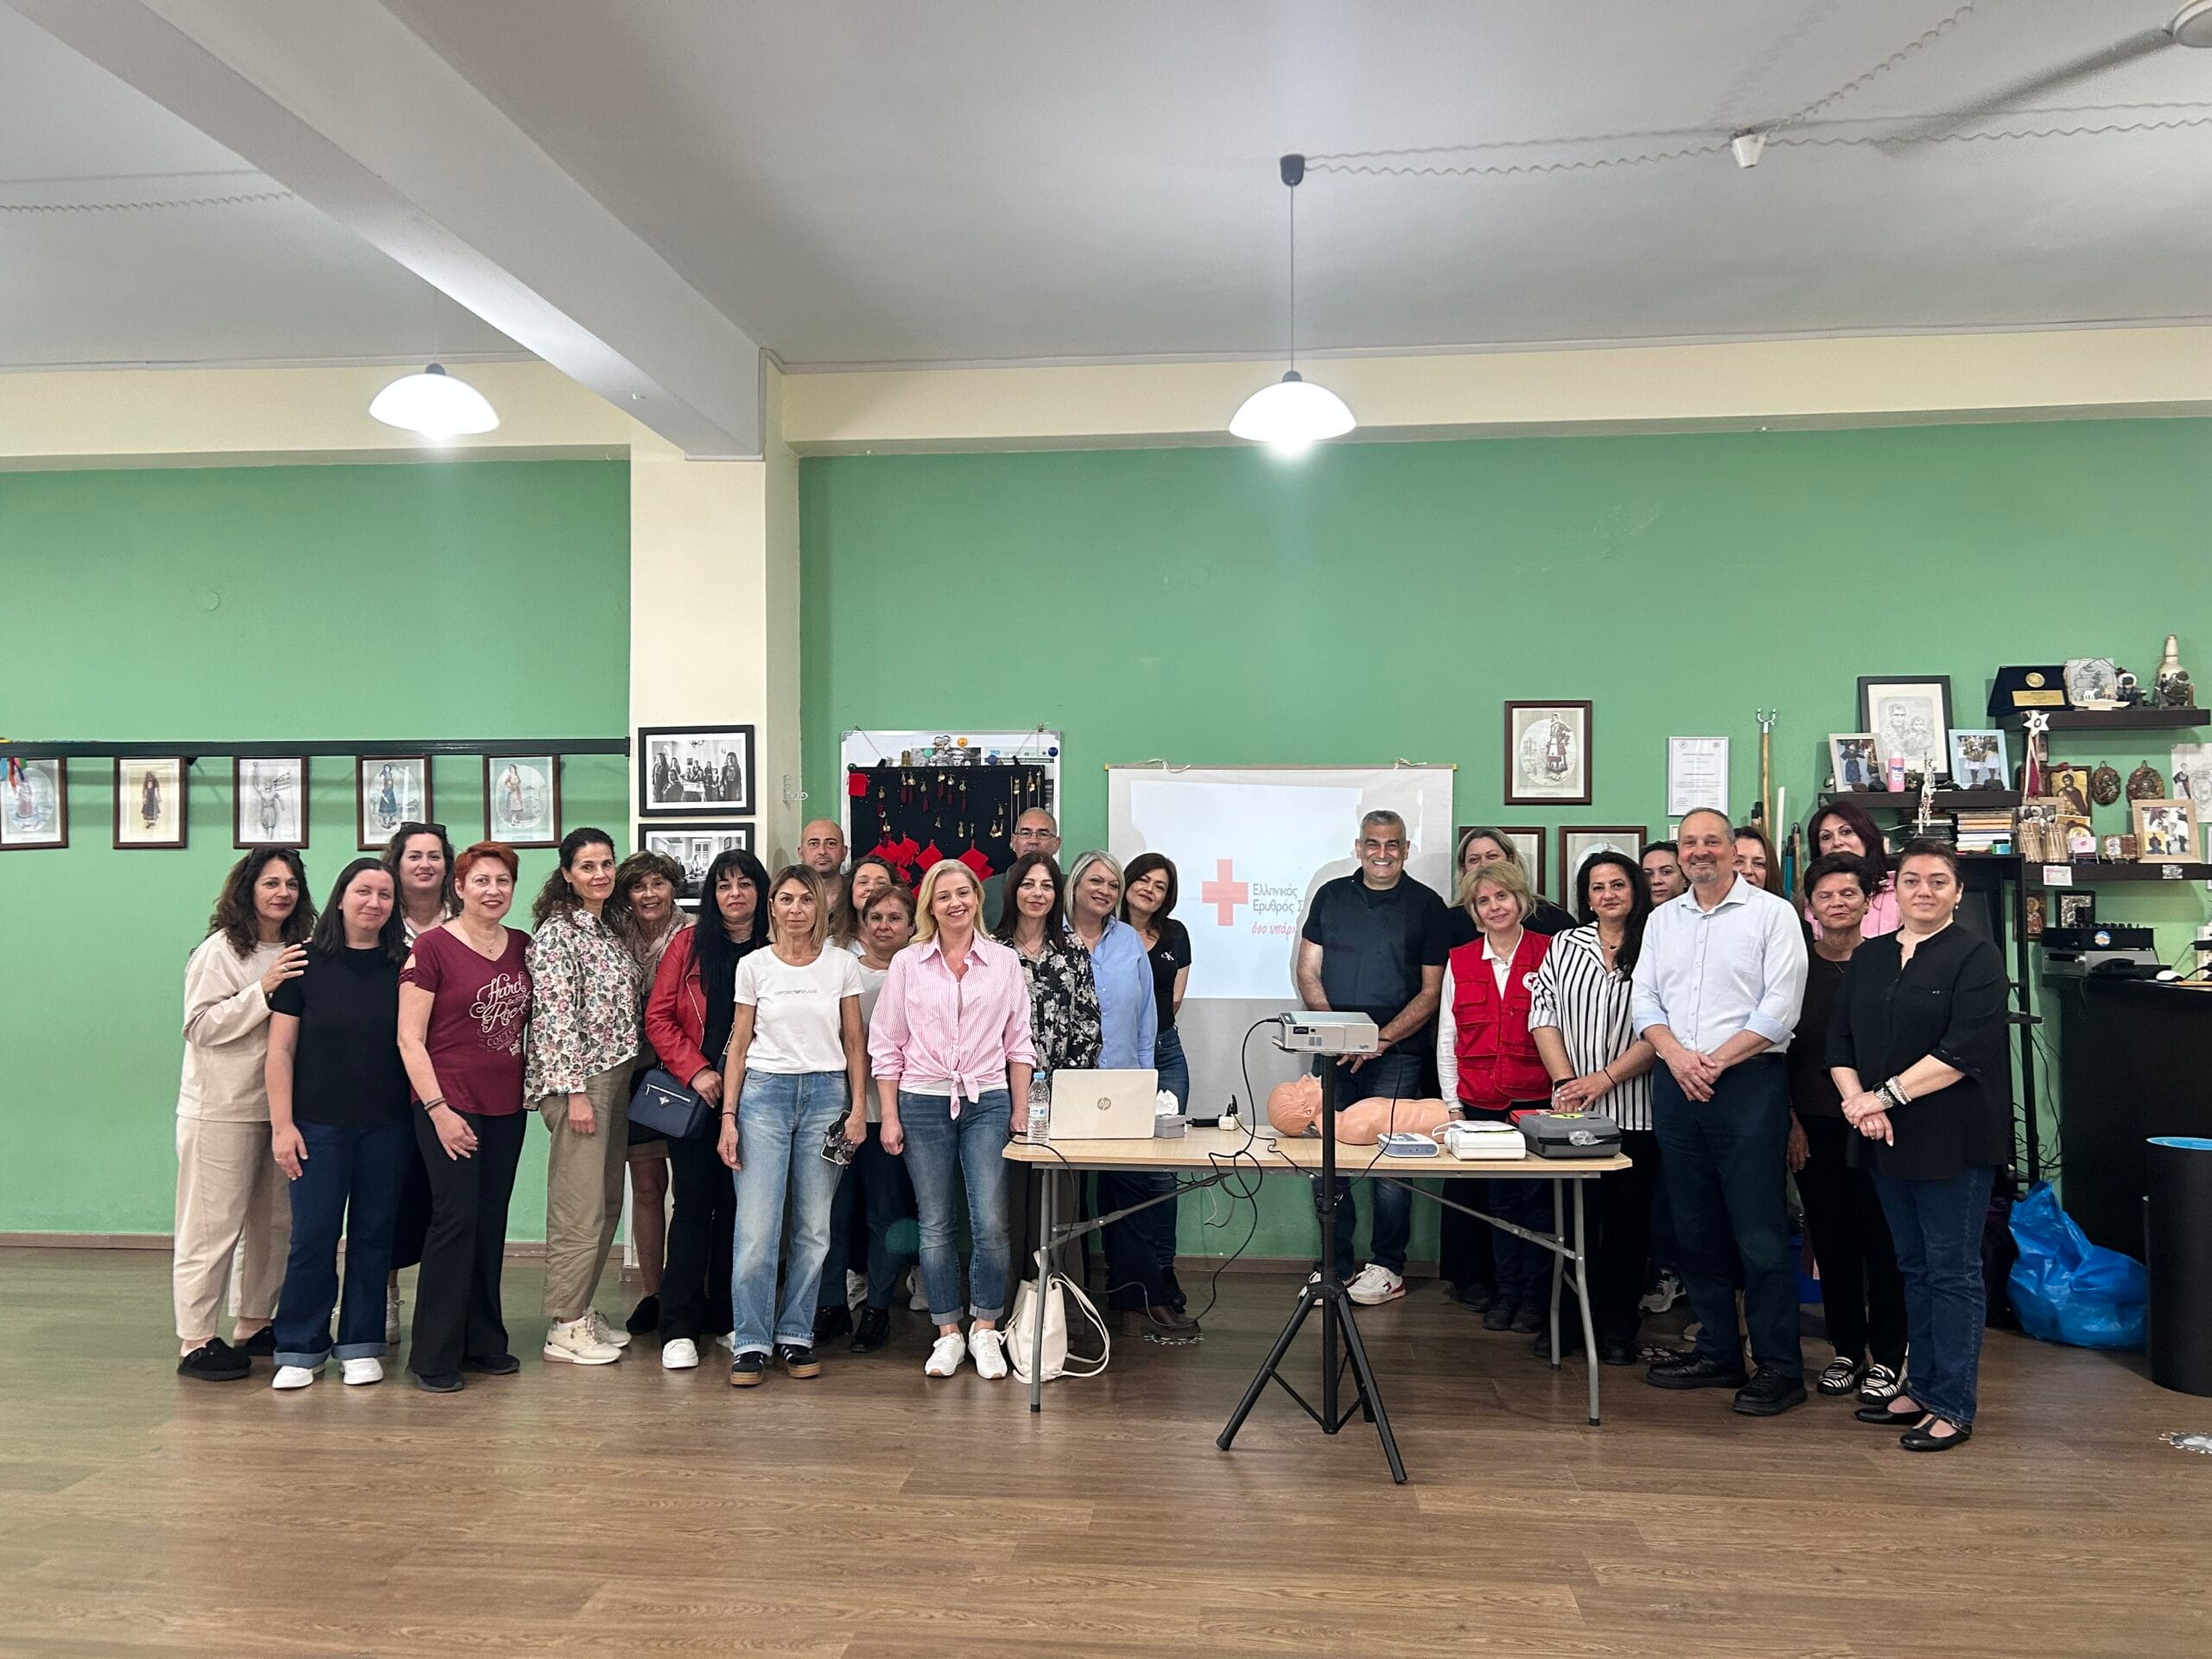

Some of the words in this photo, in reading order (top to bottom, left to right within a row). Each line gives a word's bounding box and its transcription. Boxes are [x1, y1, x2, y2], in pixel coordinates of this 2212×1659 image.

[1253, 883, 1299, 899] Ελληνικός
[1253, 899, 1294, 916] Ερυθρός
[475, 971, 527, 1008] Hard
[481, 991, 531, 1033] Rock
[1097, 1096, 1111, 1111] hp
